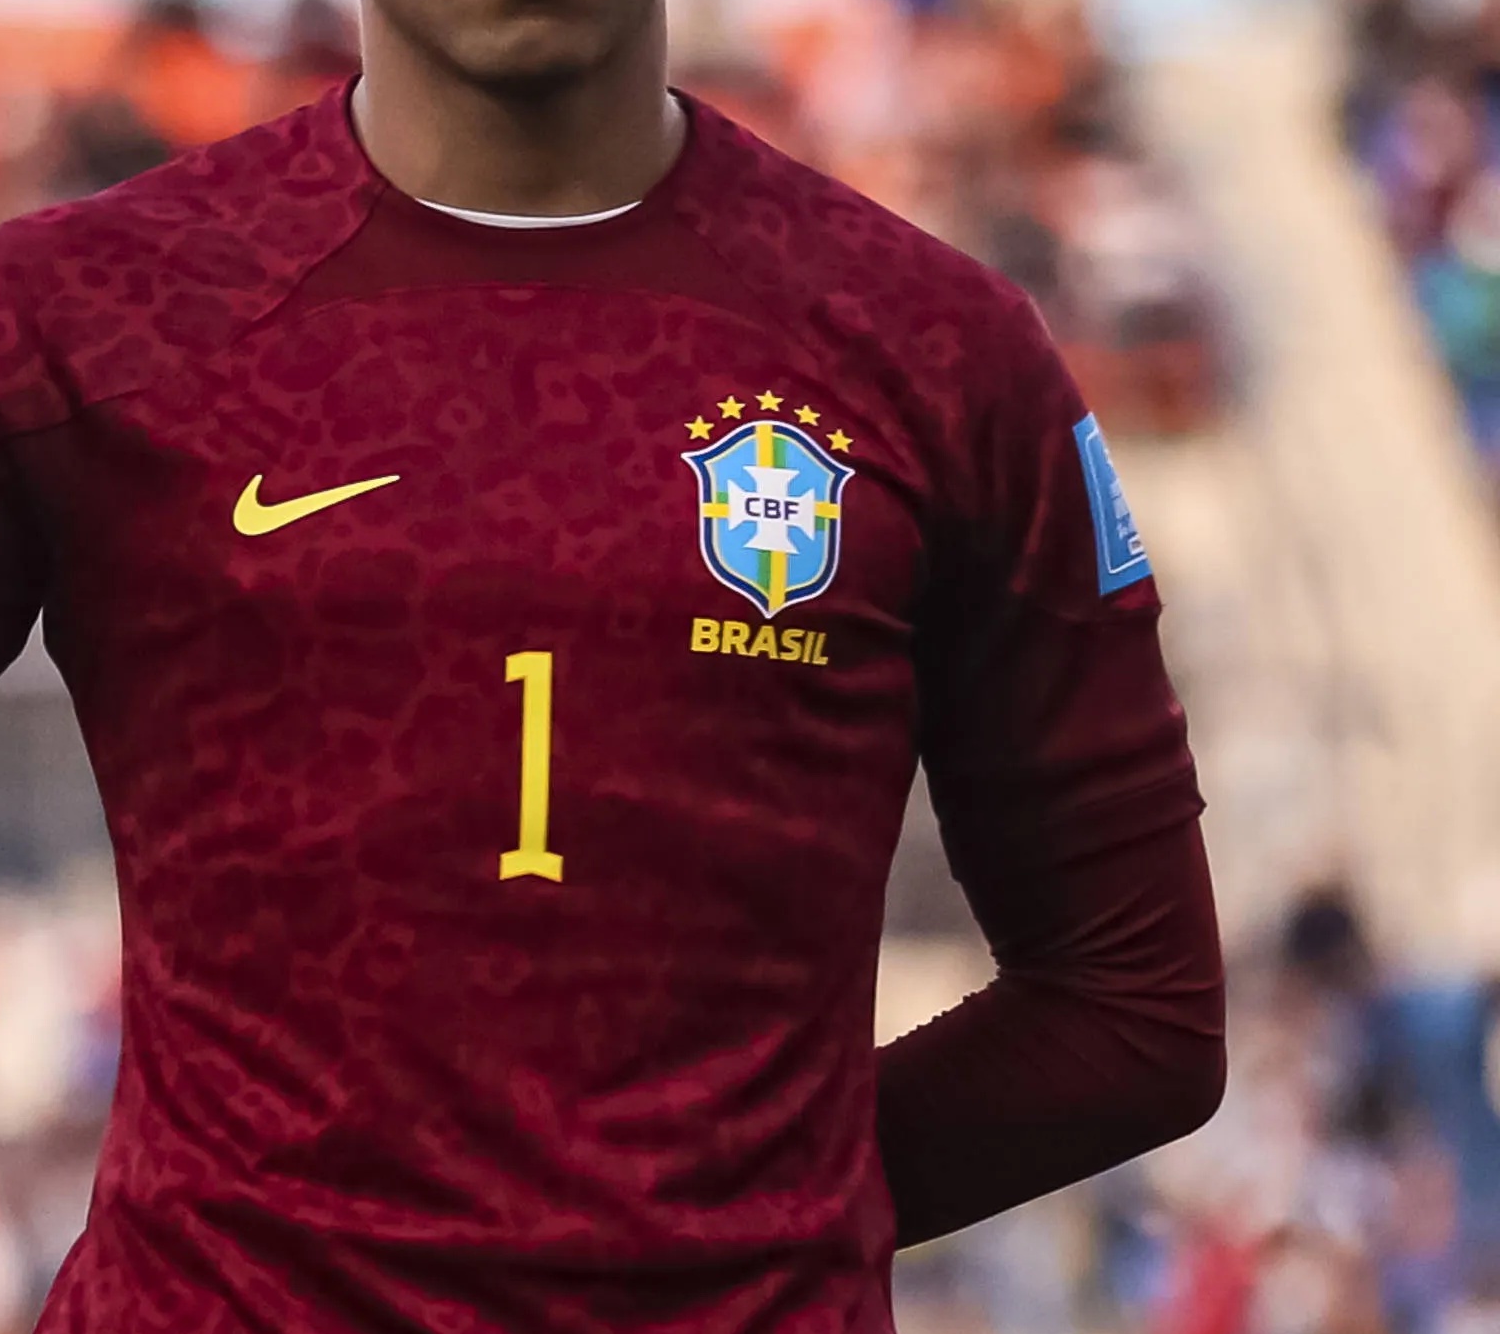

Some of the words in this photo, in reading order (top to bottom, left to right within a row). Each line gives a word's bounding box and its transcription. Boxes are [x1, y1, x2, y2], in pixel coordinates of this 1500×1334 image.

[744, 495, 800, 522] CBF
[690, 618, 829, 667] BRASIL
[499, 651, 564, 884] 1
